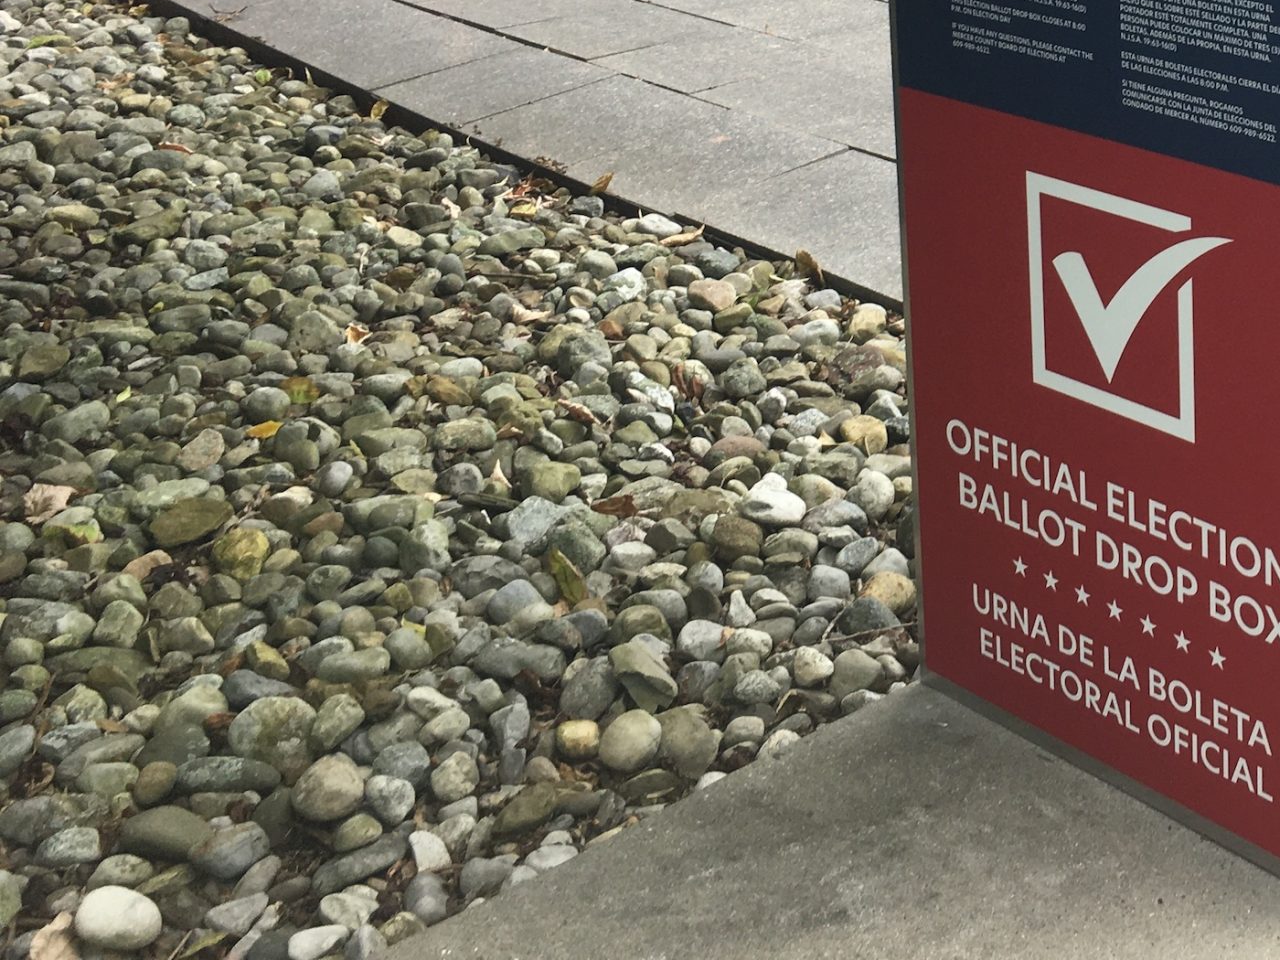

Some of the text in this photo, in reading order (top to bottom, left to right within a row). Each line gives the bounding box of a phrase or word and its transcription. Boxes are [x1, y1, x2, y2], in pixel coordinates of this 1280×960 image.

[1121, 51, 1135, 62] ESTA
[1136, 55, 1154, 66] URNA
[1155, 59, 1163, 68] DE
[1164, 61, 1192, 74] BOLETAS
[1193, 67, 1237, 84] ELECTORALES
[1238, 77, 1261, 90] CIERRA
[1262, 83, 1270, 92] EL
[1121, 61, 1129, 70] DE
[1130, 63, 1142, 72] LAS
[1142, 66, 1180, 81] ELECCIONES
[1181, 74, 1186, 82] A
[1187, 76, 1199, 85] LAS
[1122, 89, 1278, 133] COMUNICARSE CON LA JUNTA DE ELECCIONES DEL
[1122, 98, 1154, 113] CONDADO
[1154, 106, 1163, 115] DE
[1164, 108, 1189, 121] MERCER
[1190, 114, 1198, 123] AL
[1199, 115, 1228, 130] NÚMERO
[1128, 81, 1146, 91] TIENE
[1146, 85, 1172, 98] ALGUNA
[1209, 99, 1244, 114] ROGAMOS
[946, 419, 1098, 511] OFFICIAL
[959, 472, 1087, 557] BALLOT
[1096, 530, 1198, 604] DROP
[973, 583, 1272, 756] URNA DE LA BOLETA
[980, 627, 1274, 803] ELECTORAL OFICIAL
